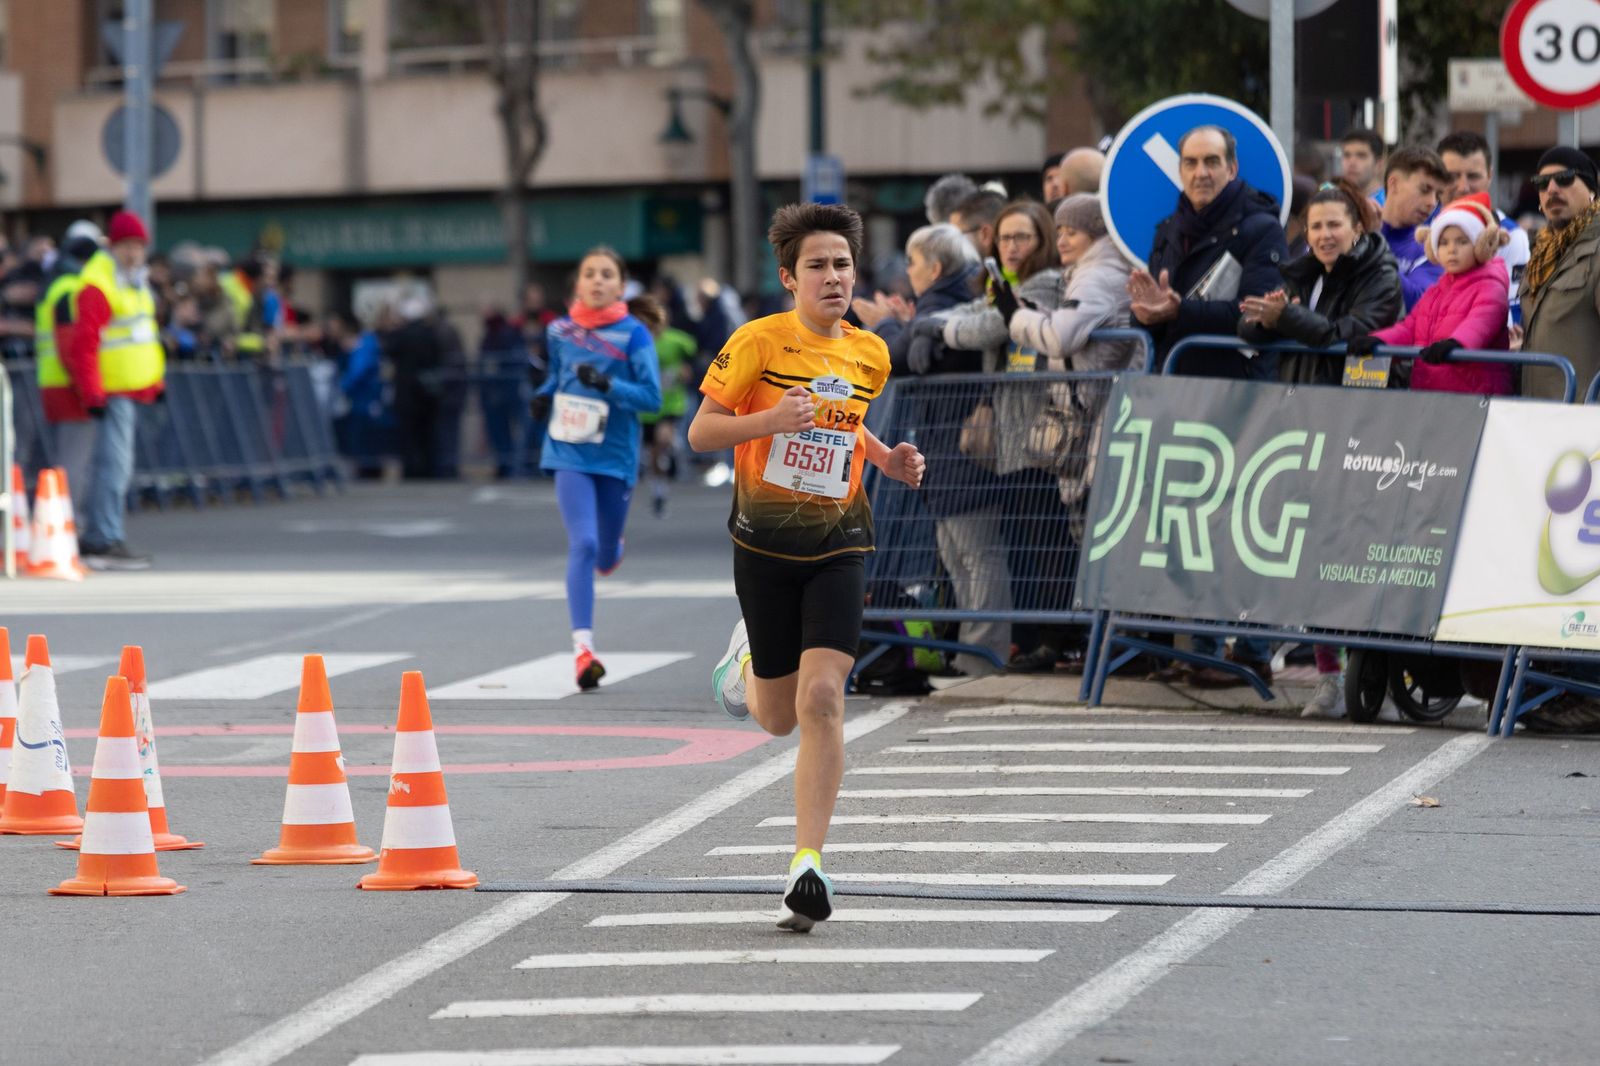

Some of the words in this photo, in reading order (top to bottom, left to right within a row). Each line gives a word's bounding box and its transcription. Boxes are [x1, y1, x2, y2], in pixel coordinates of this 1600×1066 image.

[1535, 24, 1600, 63] 30
[799, 430, 848, 447] SETEL
[1348, 438, 1360, 450] by
[783, 440, 835, 475] 6531
[1089, 394, 1326, 579] JRG
[1366, 543, 1443, 566] SOLUCIONES
[1319, 562, 1377, 584] VISUALES
[1377, 568, 1387, 584] A
[1387, 567, 1436, 588] MEDIDA
